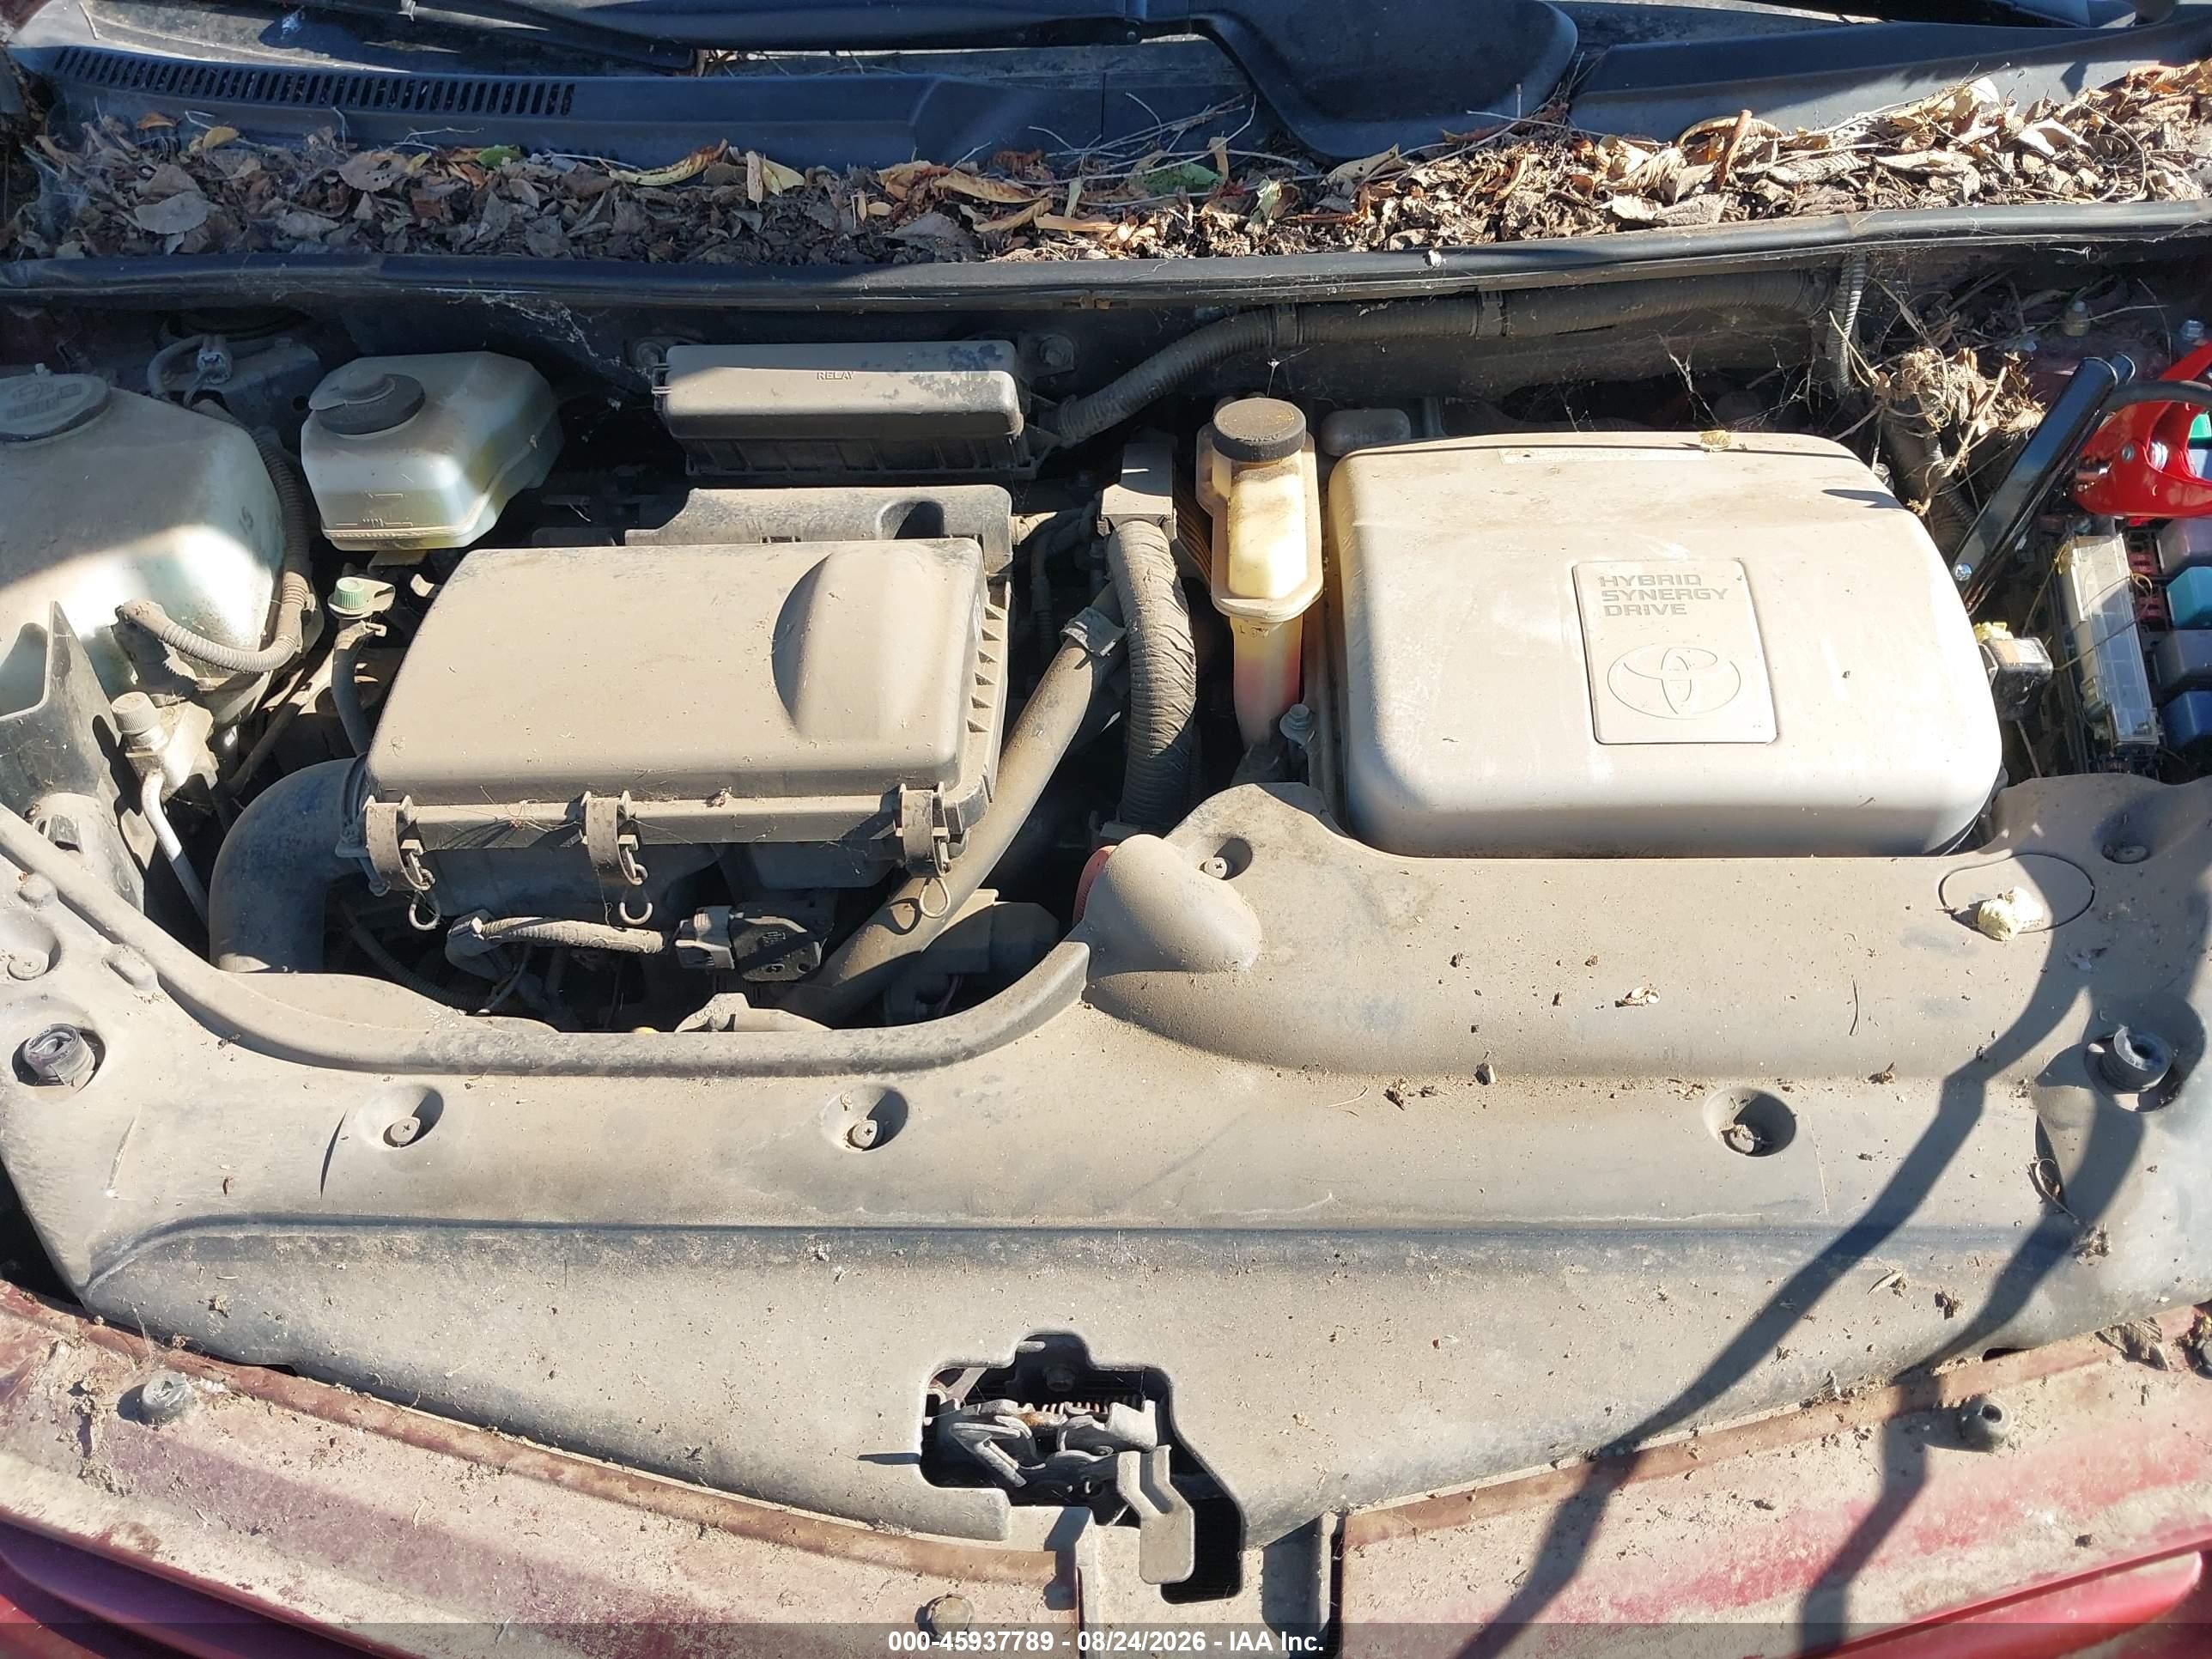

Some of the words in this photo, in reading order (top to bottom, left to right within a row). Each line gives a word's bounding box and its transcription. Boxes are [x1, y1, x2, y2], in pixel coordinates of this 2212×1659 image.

[817, 370, 854, 380] RELAY
[1599, 574, 1702, 587] HYBRID
[1601, 588, 1729, 601] SYNERGY
[1603, 604, 1687, 617] DRIVE
